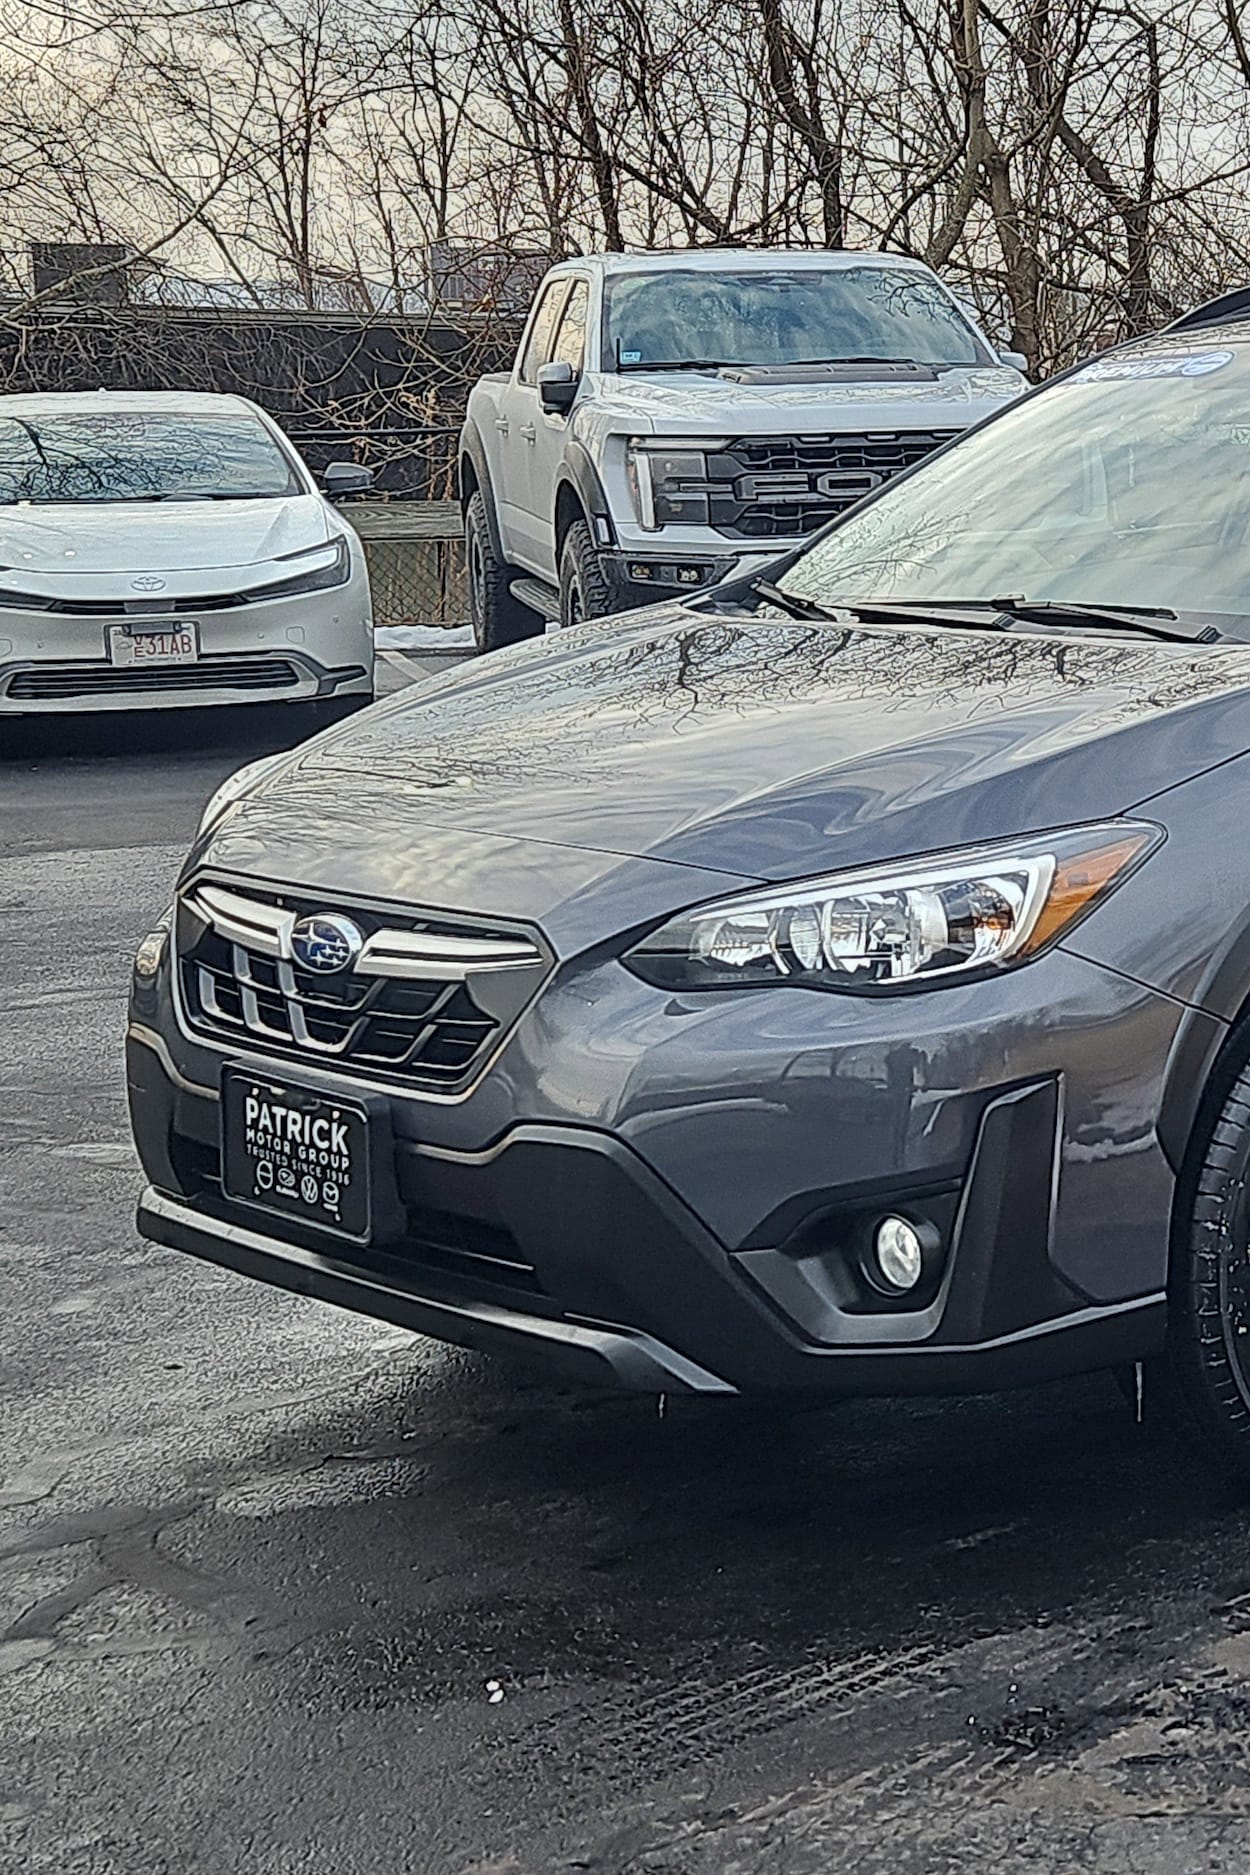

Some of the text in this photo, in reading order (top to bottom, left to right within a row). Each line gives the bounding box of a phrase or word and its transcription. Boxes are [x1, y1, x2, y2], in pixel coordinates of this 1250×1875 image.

[245, 1096, 349, 1155] PATRICK
[246, 1128, 349, 1171] MOTOR GROUP
[247, 1143, 288, 1167] TRUSTED
[292, 1158, 321, 1178] SINCE
